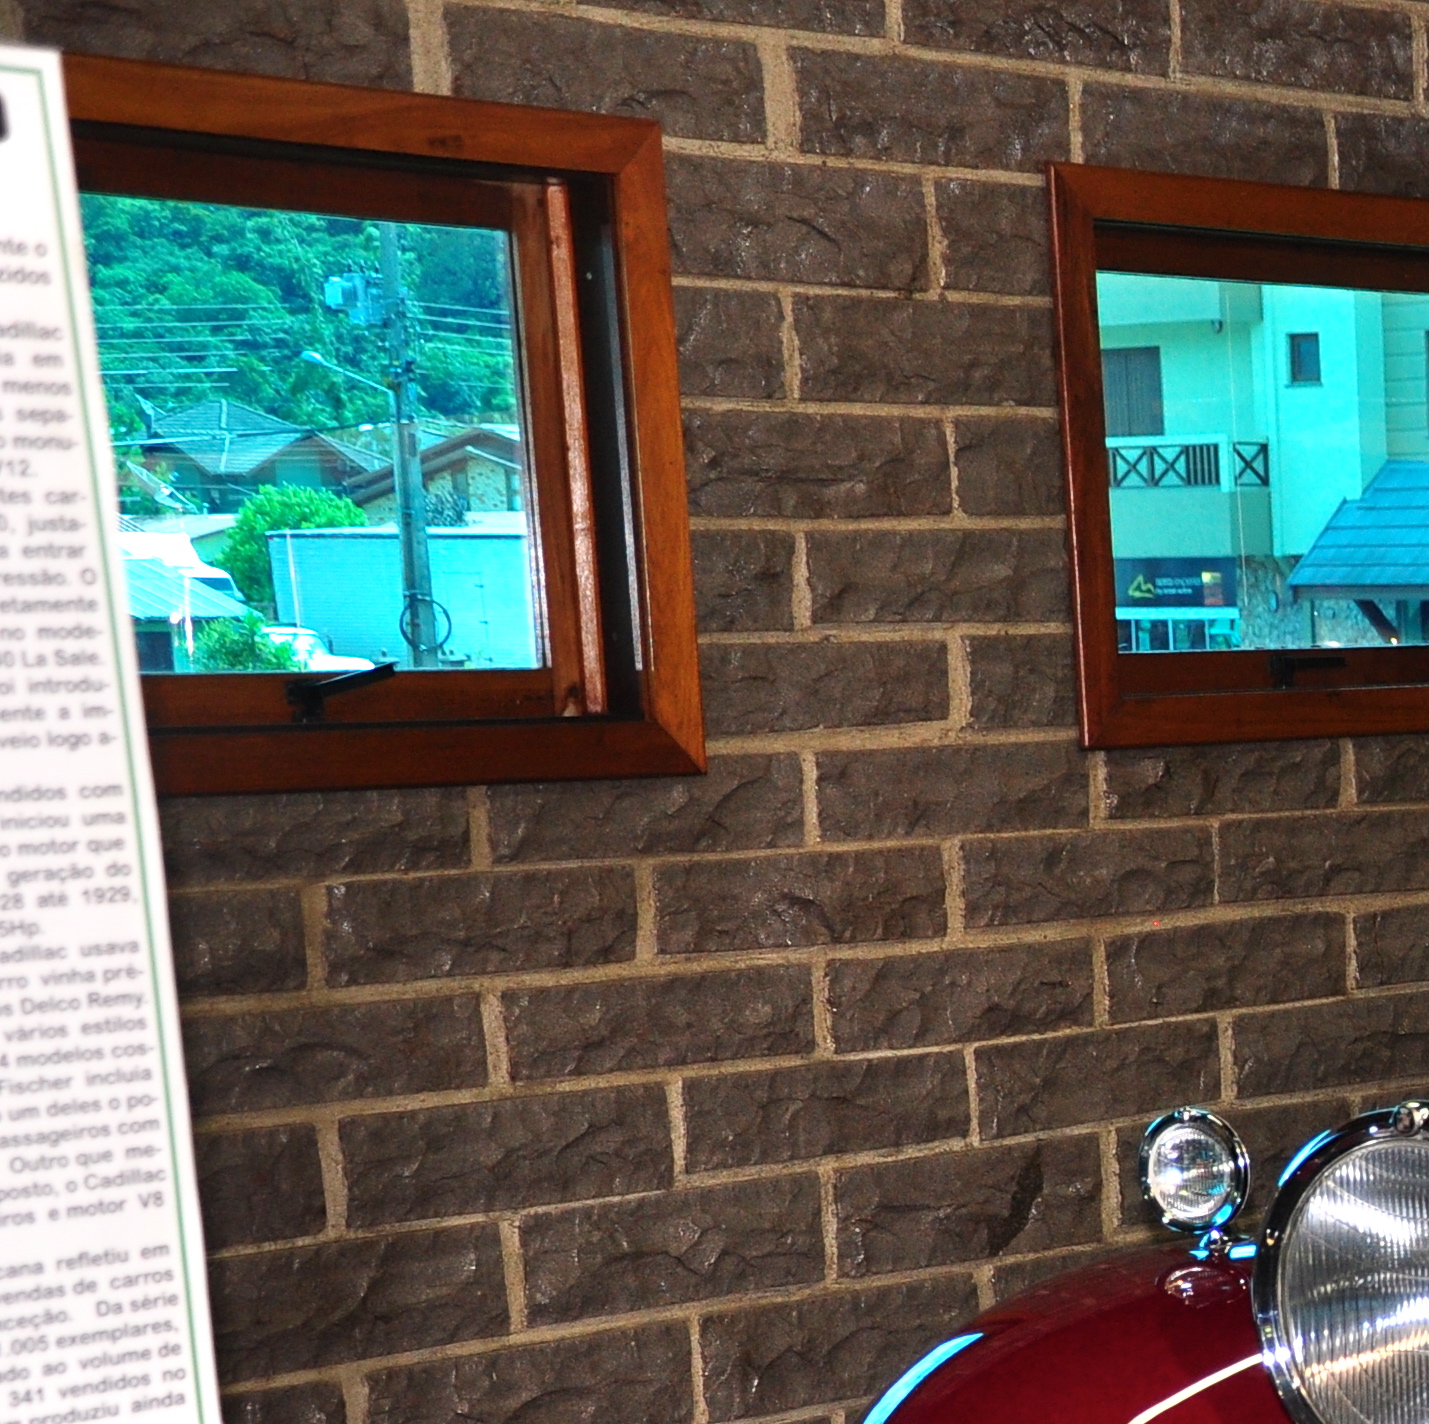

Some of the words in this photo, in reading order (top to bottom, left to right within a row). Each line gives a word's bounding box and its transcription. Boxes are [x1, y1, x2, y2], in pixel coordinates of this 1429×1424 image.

[1, 380, 72, 396] menos
[27, 515, 85, 536] justa-
[21, 543, 85, 559] entrar
[79, 567, 97, 586] O
[36, 623, 102, 640] mode-
[21, 651, 48, 668] La
[28, 677, 109, 693] introdu-
[58, 707, 70, 720] a
[47, 732, 91, 751] logo
[79, 784, 123, 799] com
[82, 812, 126, 826] uma
[17, 839, 79, 855] motor
[86, 838, 125, 854] que
[8, 863, 95, 888] geração
[105, 861, 131, 878] do
[37, 891, 68, 908] até
[80, 941, 139, 957] usava
[40, 969, 96, 986] vinha
[20, 997, 81, 1015] Delco
[4, 1025, 68, 1042] vários
[80, 1017, 147, 1035] estilos
[16, 1044, 105, 1066] modelos
[111, 1043, 155, 1058] cos-
[8, 1106, 40, 1122] um
[46, 1099, 102, 1117] deles
[108, 1097, 121, 1111] o
[126, 1094, 159, 1112] po-
[117, 1119, 160, 1135] com
[9, 1155, 69, 1174] Outro
[75, 1150, 113, 1168] que
[125, 1145, 163, 1158] me-
[65, 1180, 78, 1193] o
[84, 1168, 166, 1191] Cadillac
[48, 1208, 60, 1221] e
[66, 1200, 126, 1217] motor
[138, 1191, 164, 1208] V8
[56, 1249, 129, 1270] refletiu
[140, 1245, 169, 1259] em
[72, 1279, 97, 1295] de
[110, 1269, 173, 1289] carros
[96, 1300, 123, 1317] Da
[130, 1294, 178, 1312] série
[56, 1320, 180, 1346] exemplares,
[42, 1362, 67, 1376] ao
[79, 1349, 151, 1370] volume
[158, 1342, 181, 1358] de
[9, 1388, 43, 1407] 341
[59, 1374, 152, 1399] vendidos
[162, 1368, 186, 1381] no
[132, 1392, 185, 1412] ainda
